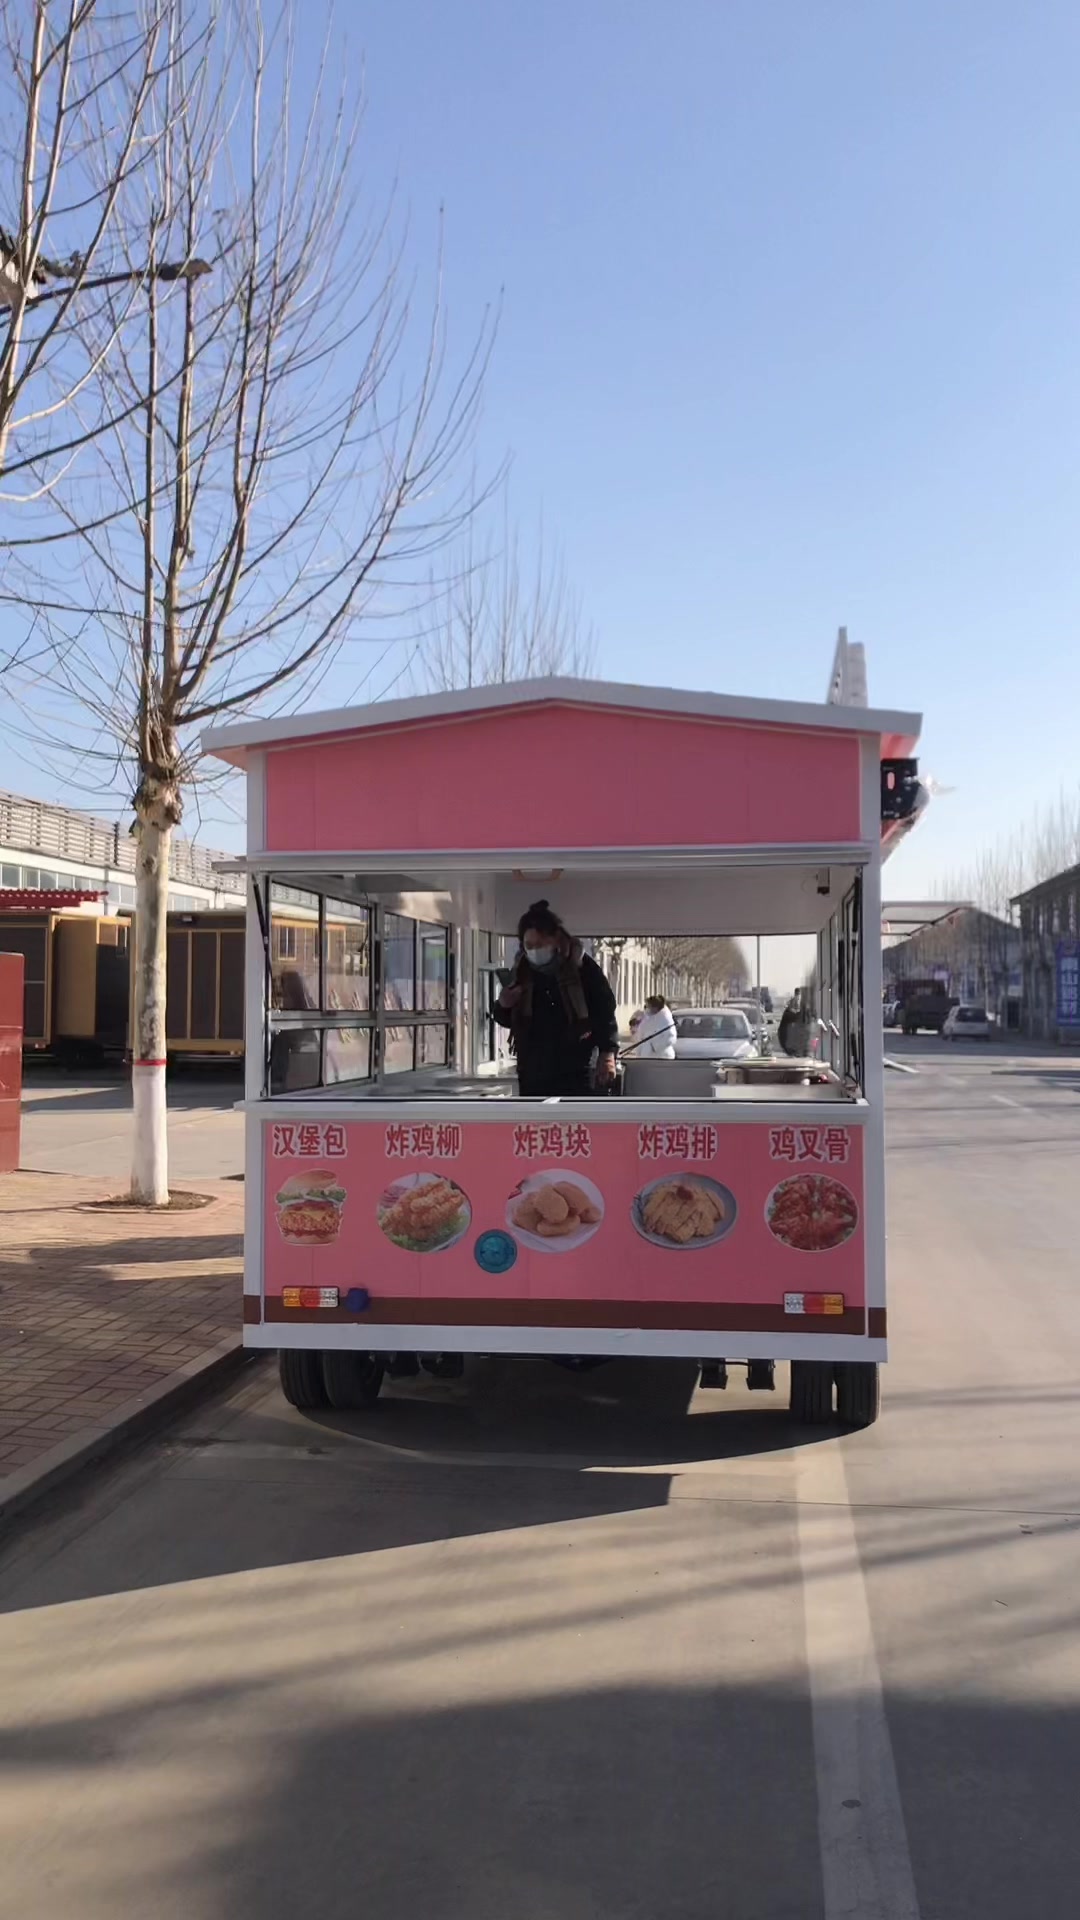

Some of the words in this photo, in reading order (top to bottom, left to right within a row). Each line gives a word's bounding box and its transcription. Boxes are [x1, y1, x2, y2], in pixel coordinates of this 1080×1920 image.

[272, 1124, 346, 1157] 汉堡包
[385, 1124, 461, 1157] 炸鸡柳
[514, 1123, 590, 1157] 炸鸡块
[639, 1124, 716, 1159] 炸鸡排
[770, 1126, 849, 1161] 鸡叉骨
